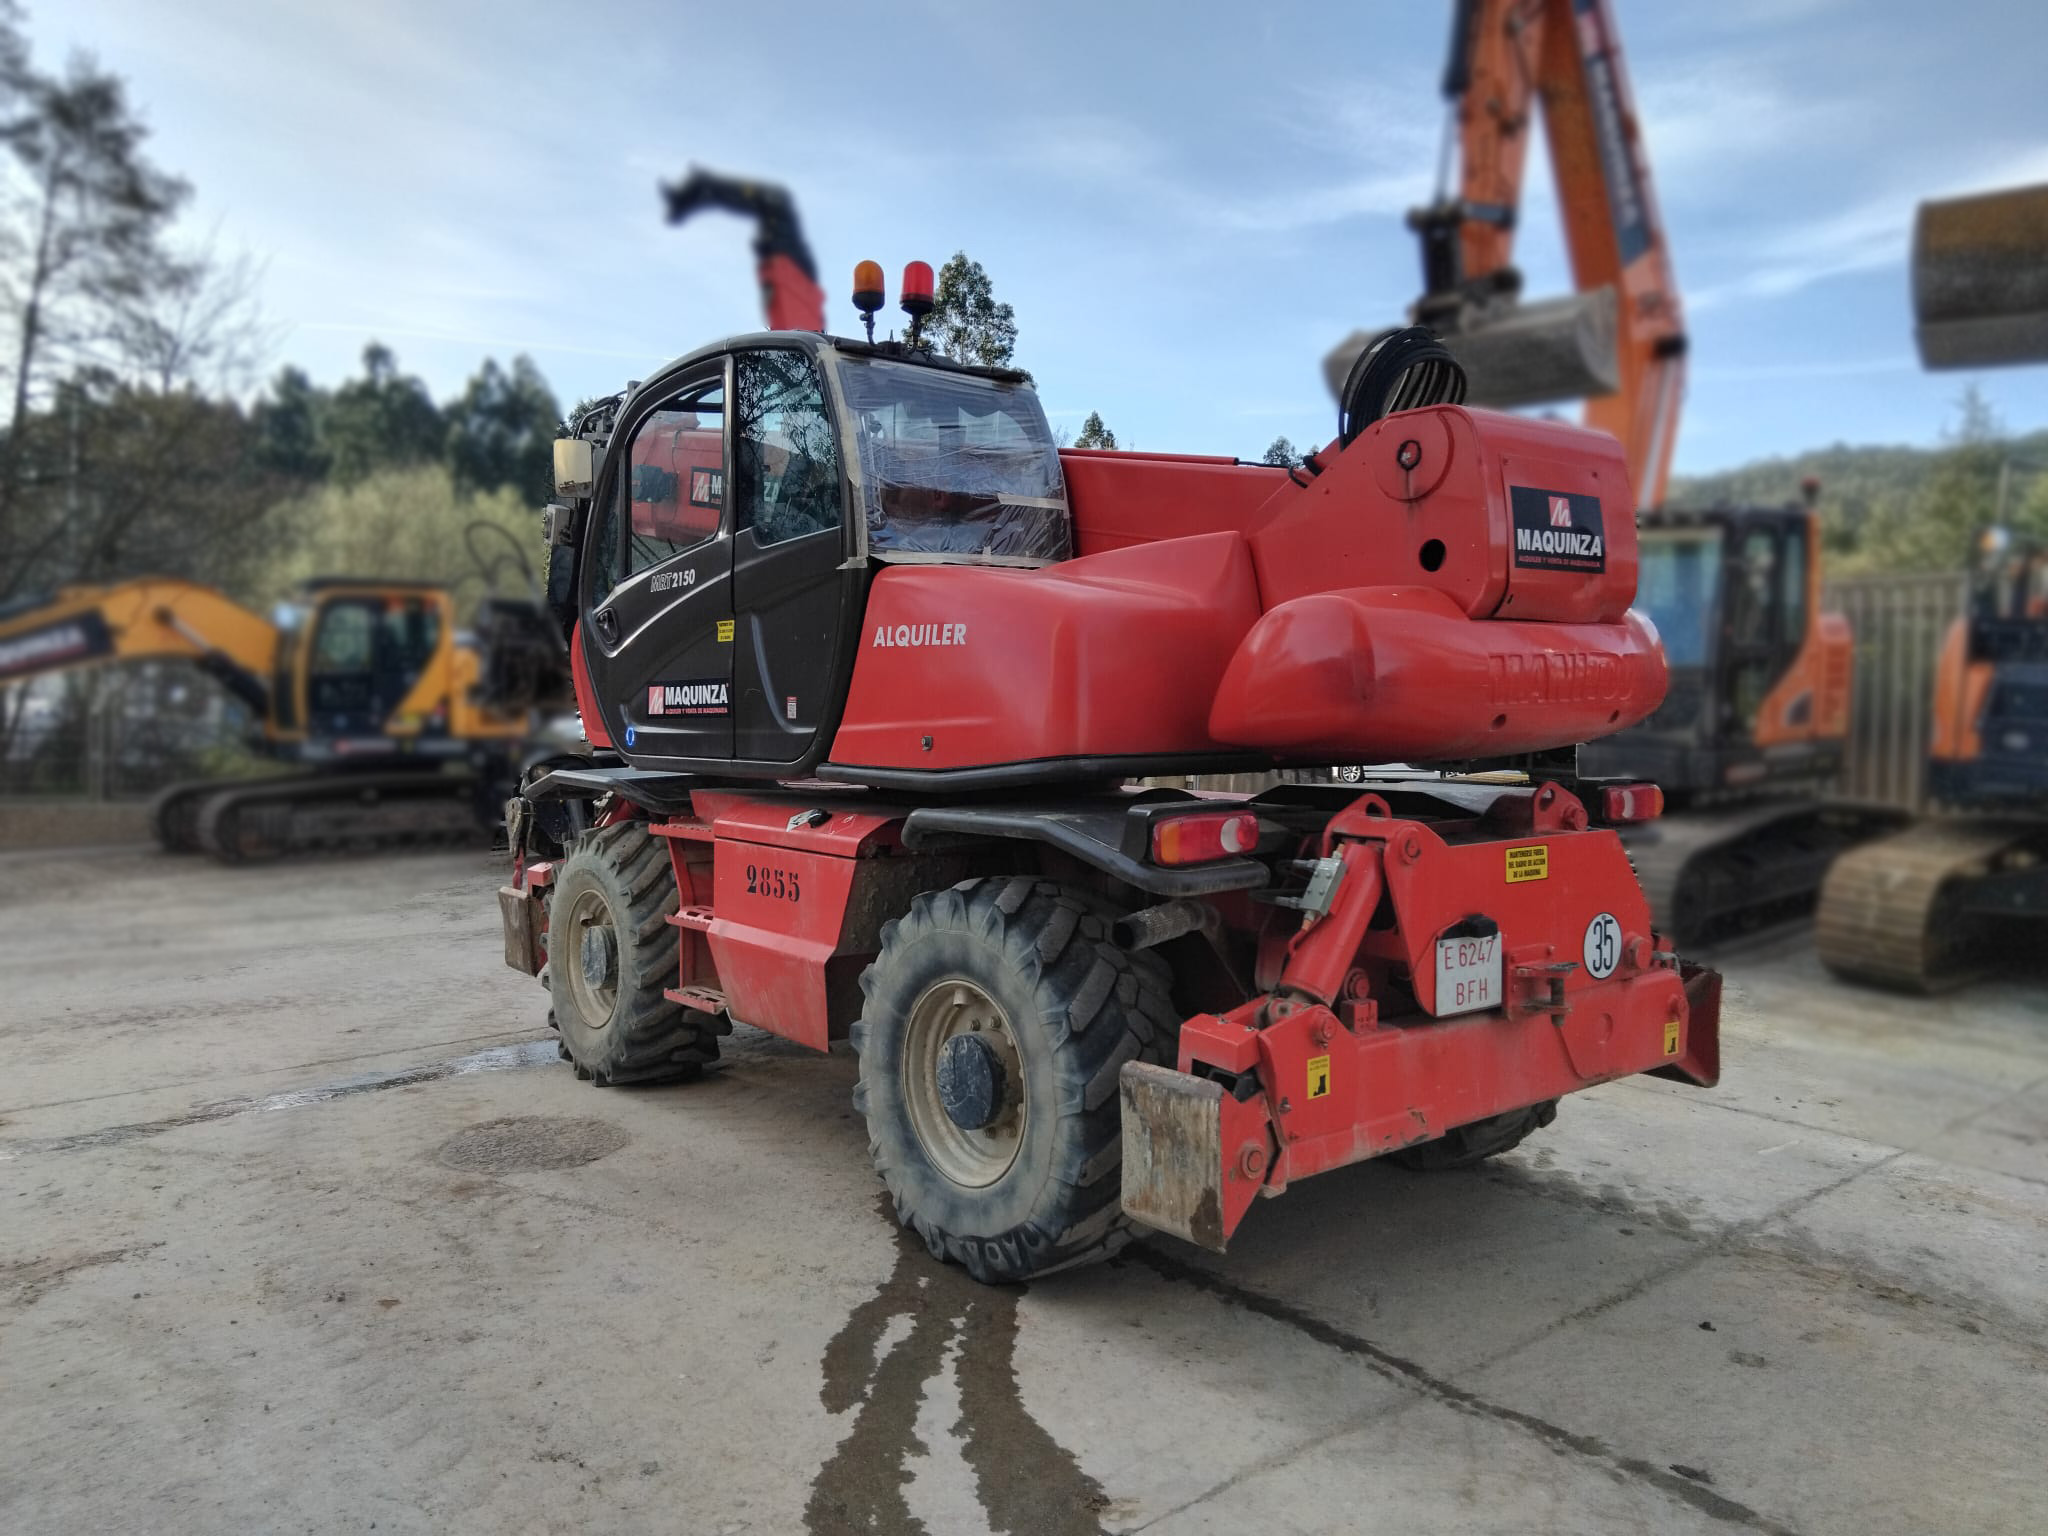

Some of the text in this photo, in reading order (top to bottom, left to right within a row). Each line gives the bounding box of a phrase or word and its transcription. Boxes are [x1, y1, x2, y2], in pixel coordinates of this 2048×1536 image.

[1517, 528, 1602, 557] MAQUINZA
[872, 623, 967, 648] ALQUILER
[665, 683, 728, 706] MAQUINZA
[746, 864, 800, 902] 2855
[1444, 939, 1494, 971] E 6247
[1593, 919, 1613, 972] 35
[1455, 976, 1488, 1006] BFH
